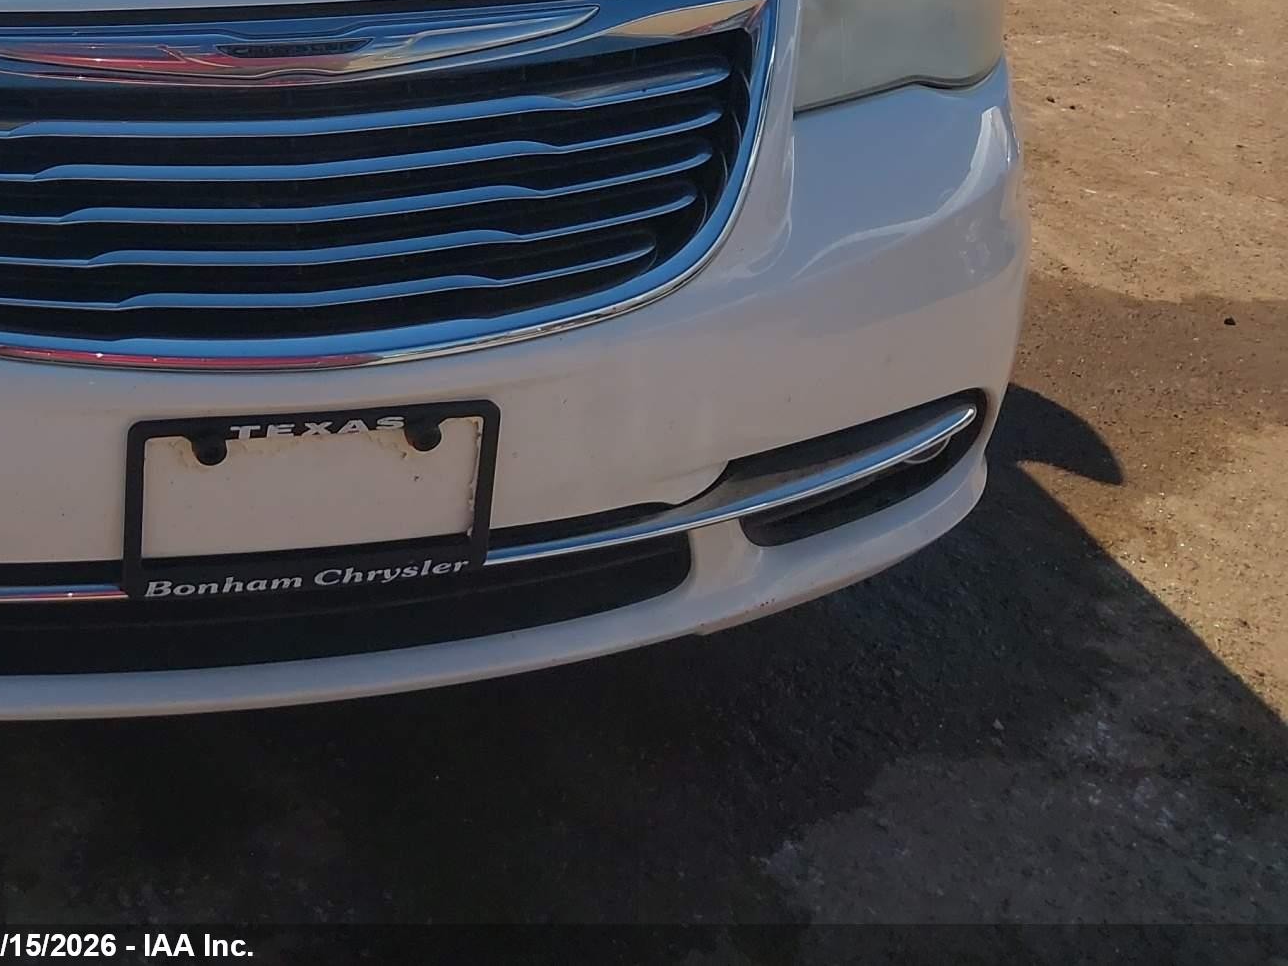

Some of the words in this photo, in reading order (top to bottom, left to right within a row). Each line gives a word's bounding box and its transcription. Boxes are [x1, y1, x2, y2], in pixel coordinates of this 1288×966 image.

[230, 416, 406, 440] TEXAS
[145, 574, 303, 598] Bonham
[314, 558, 470, 586] Chrysler
